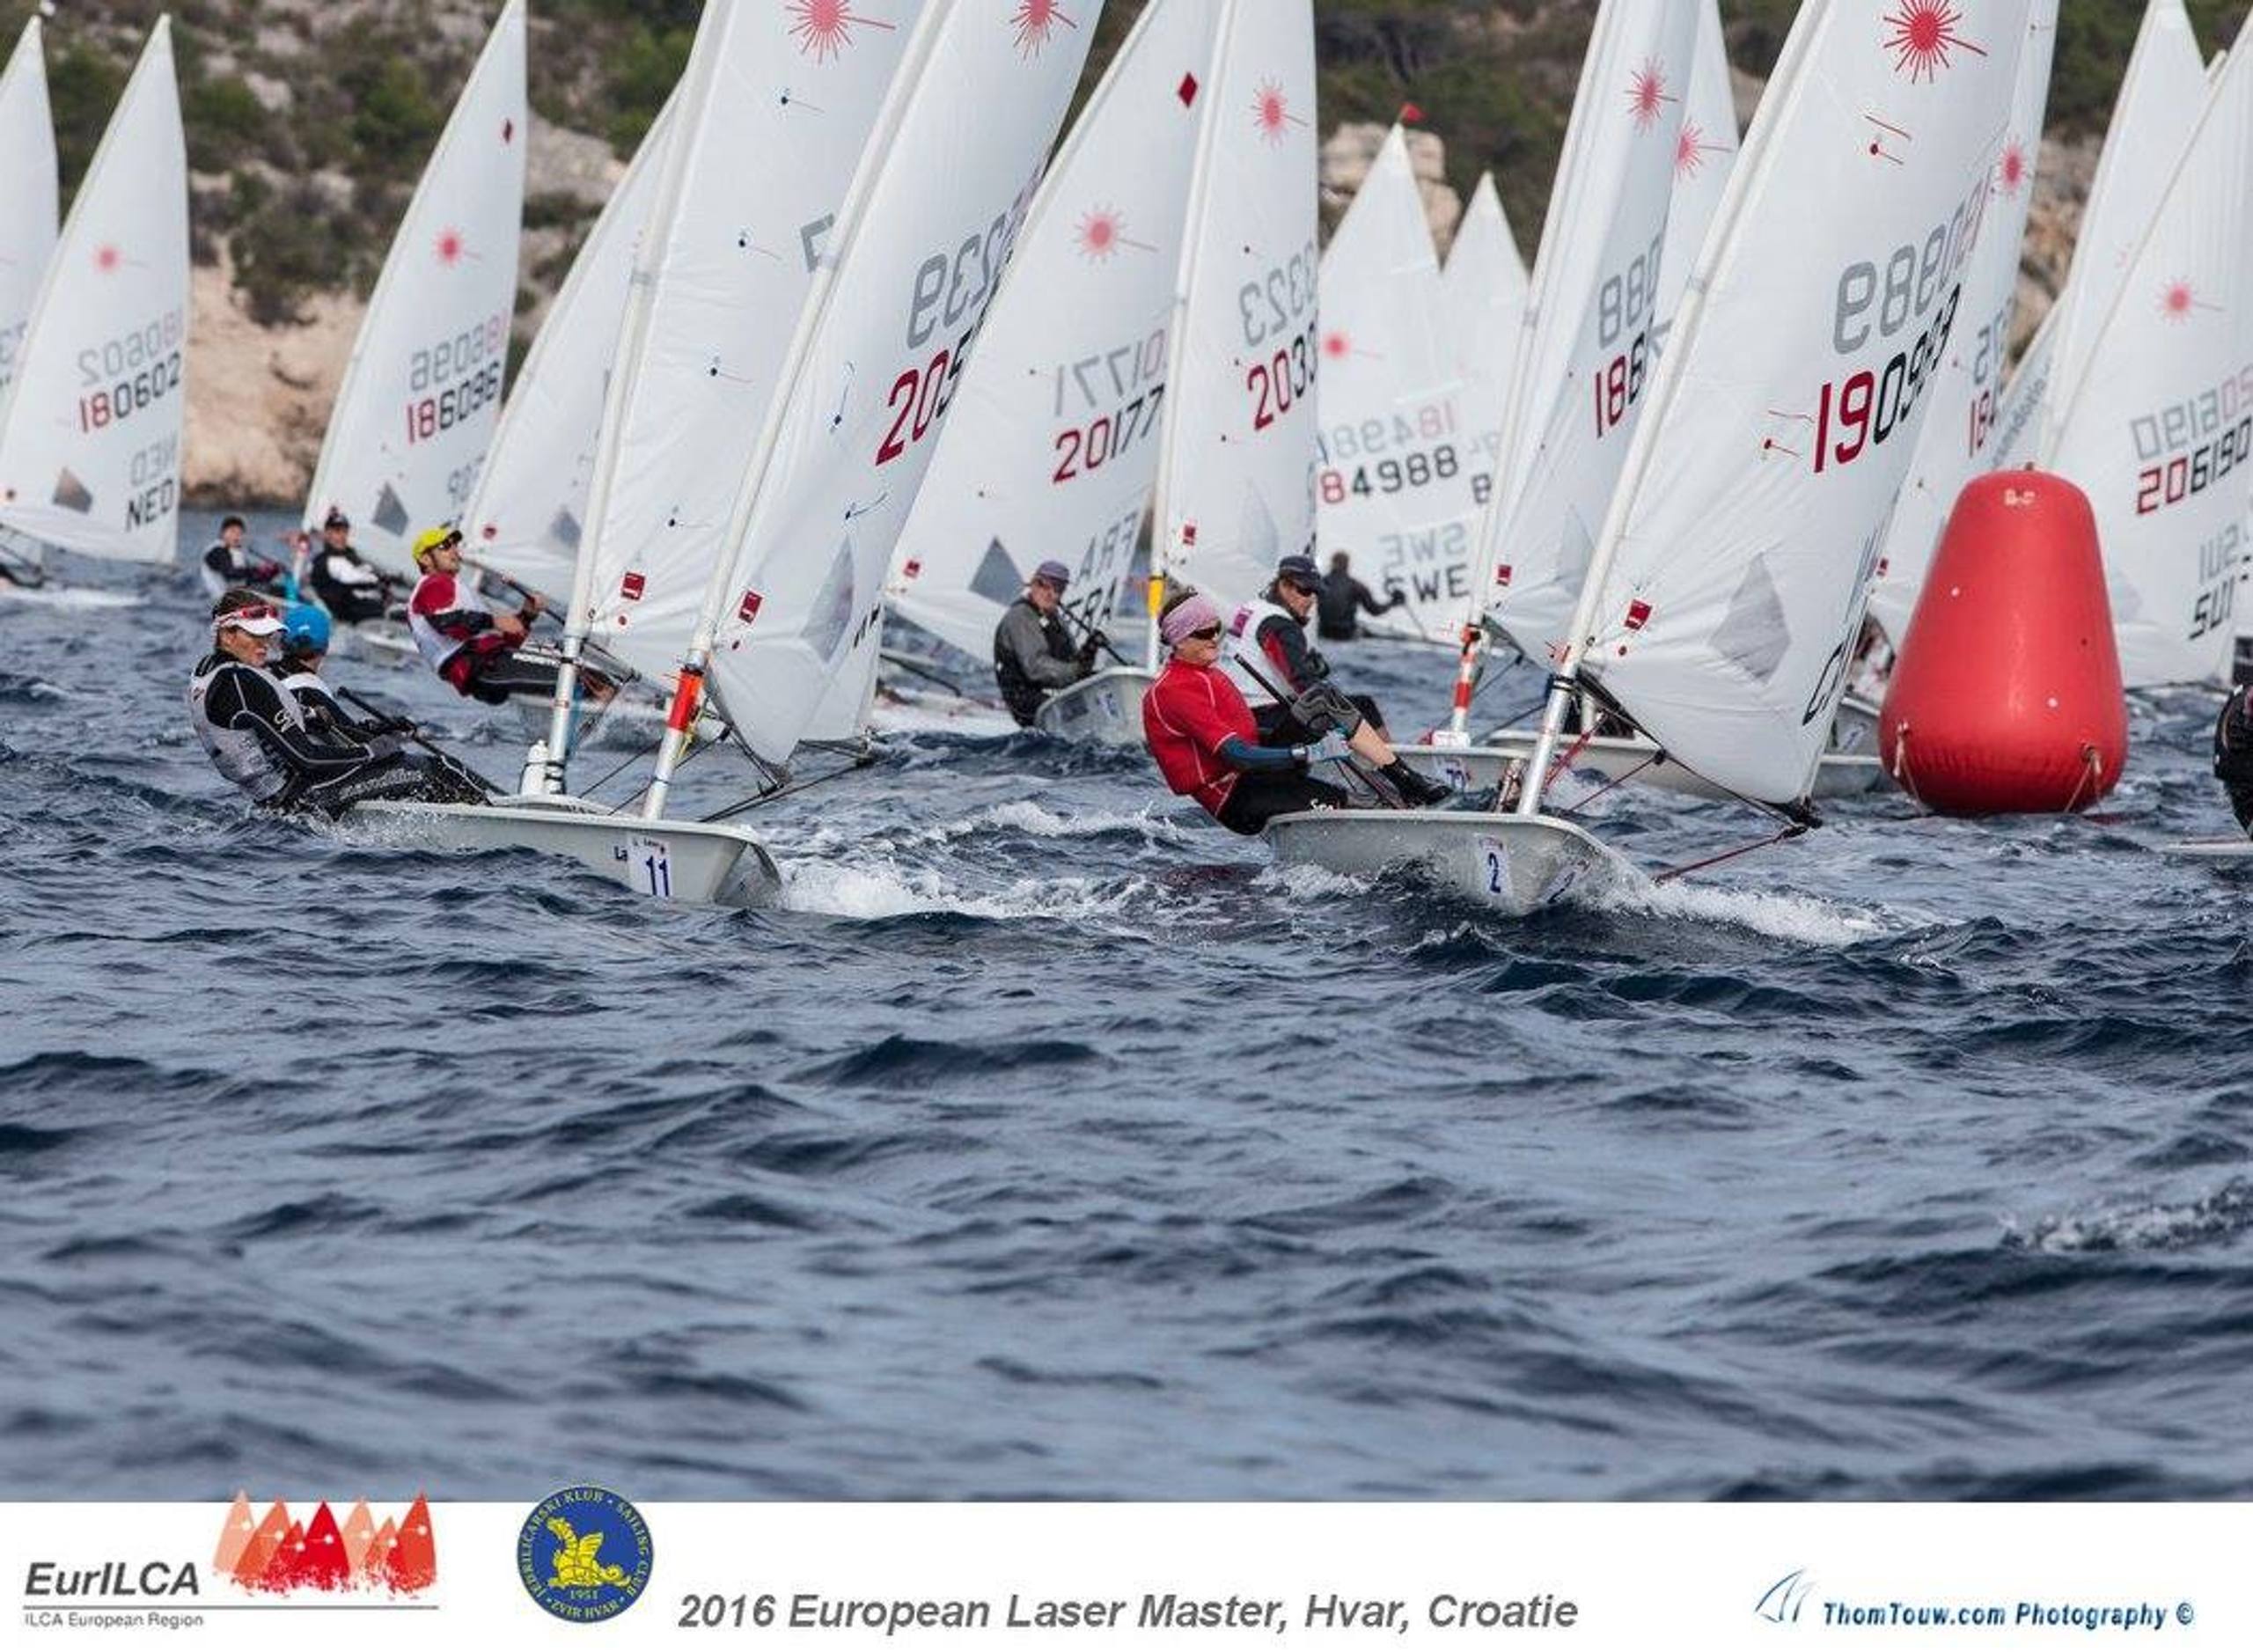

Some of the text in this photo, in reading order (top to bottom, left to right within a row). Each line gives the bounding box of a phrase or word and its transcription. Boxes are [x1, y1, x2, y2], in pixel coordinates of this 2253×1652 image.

[80, 351, 181, 433] 180602
[2136, 415, 2252, 514] 206190
[124, 478, 173, 532] NED
[645, 855, 670, 896] 11
[1488, 852, 1501, 893] 2
